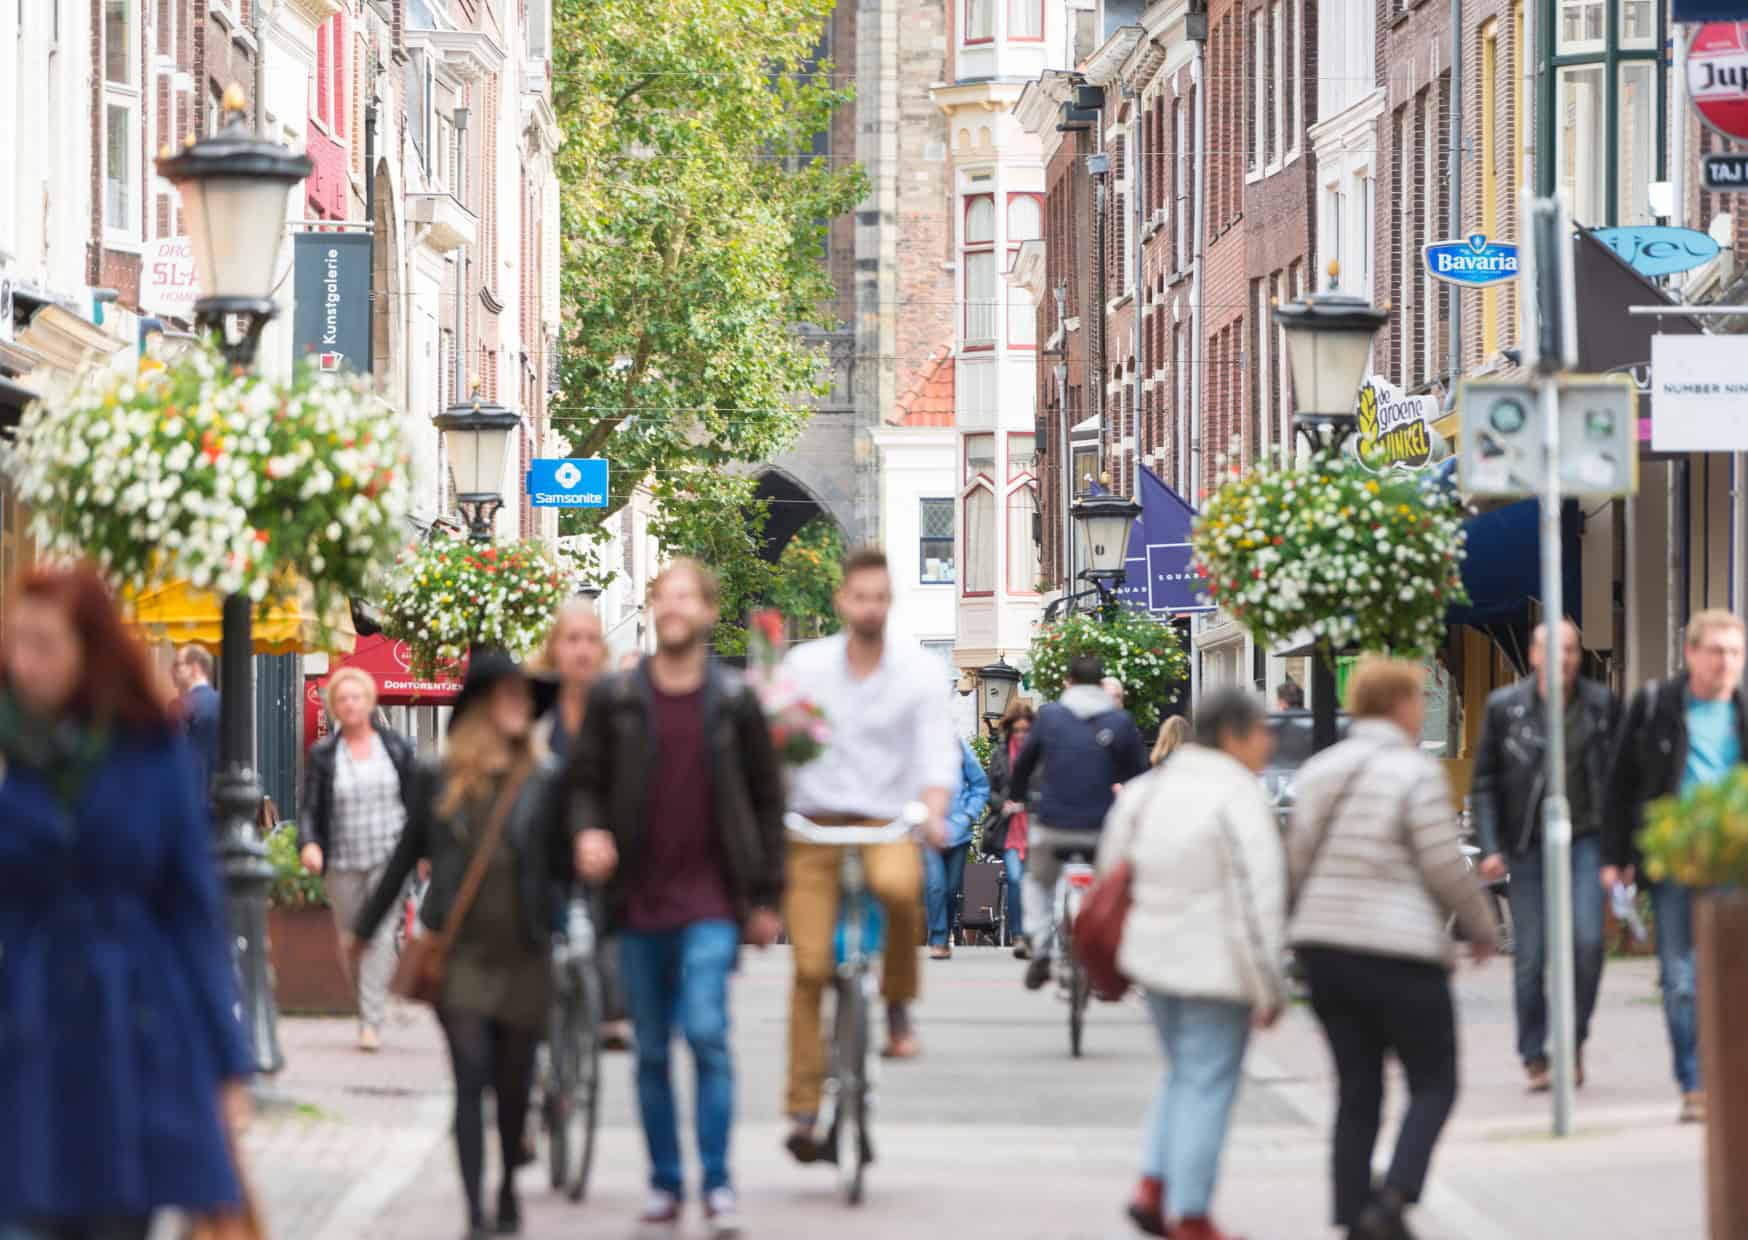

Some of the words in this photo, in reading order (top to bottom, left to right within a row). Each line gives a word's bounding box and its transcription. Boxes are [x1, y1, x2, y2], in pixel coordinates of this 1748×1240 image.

[1709, 163, 1741, 181] TAJ
[1437, 251, 1518, 272] Bavaria
[322, 248, 340, 345] Kunstgalerie
[1378, 386, 1391, 405] de
[1663, 383, 1720, 393] NUMBER
[1379, 399, 1423, 431] groene
[535, 492, 602, 504] Samsonite
